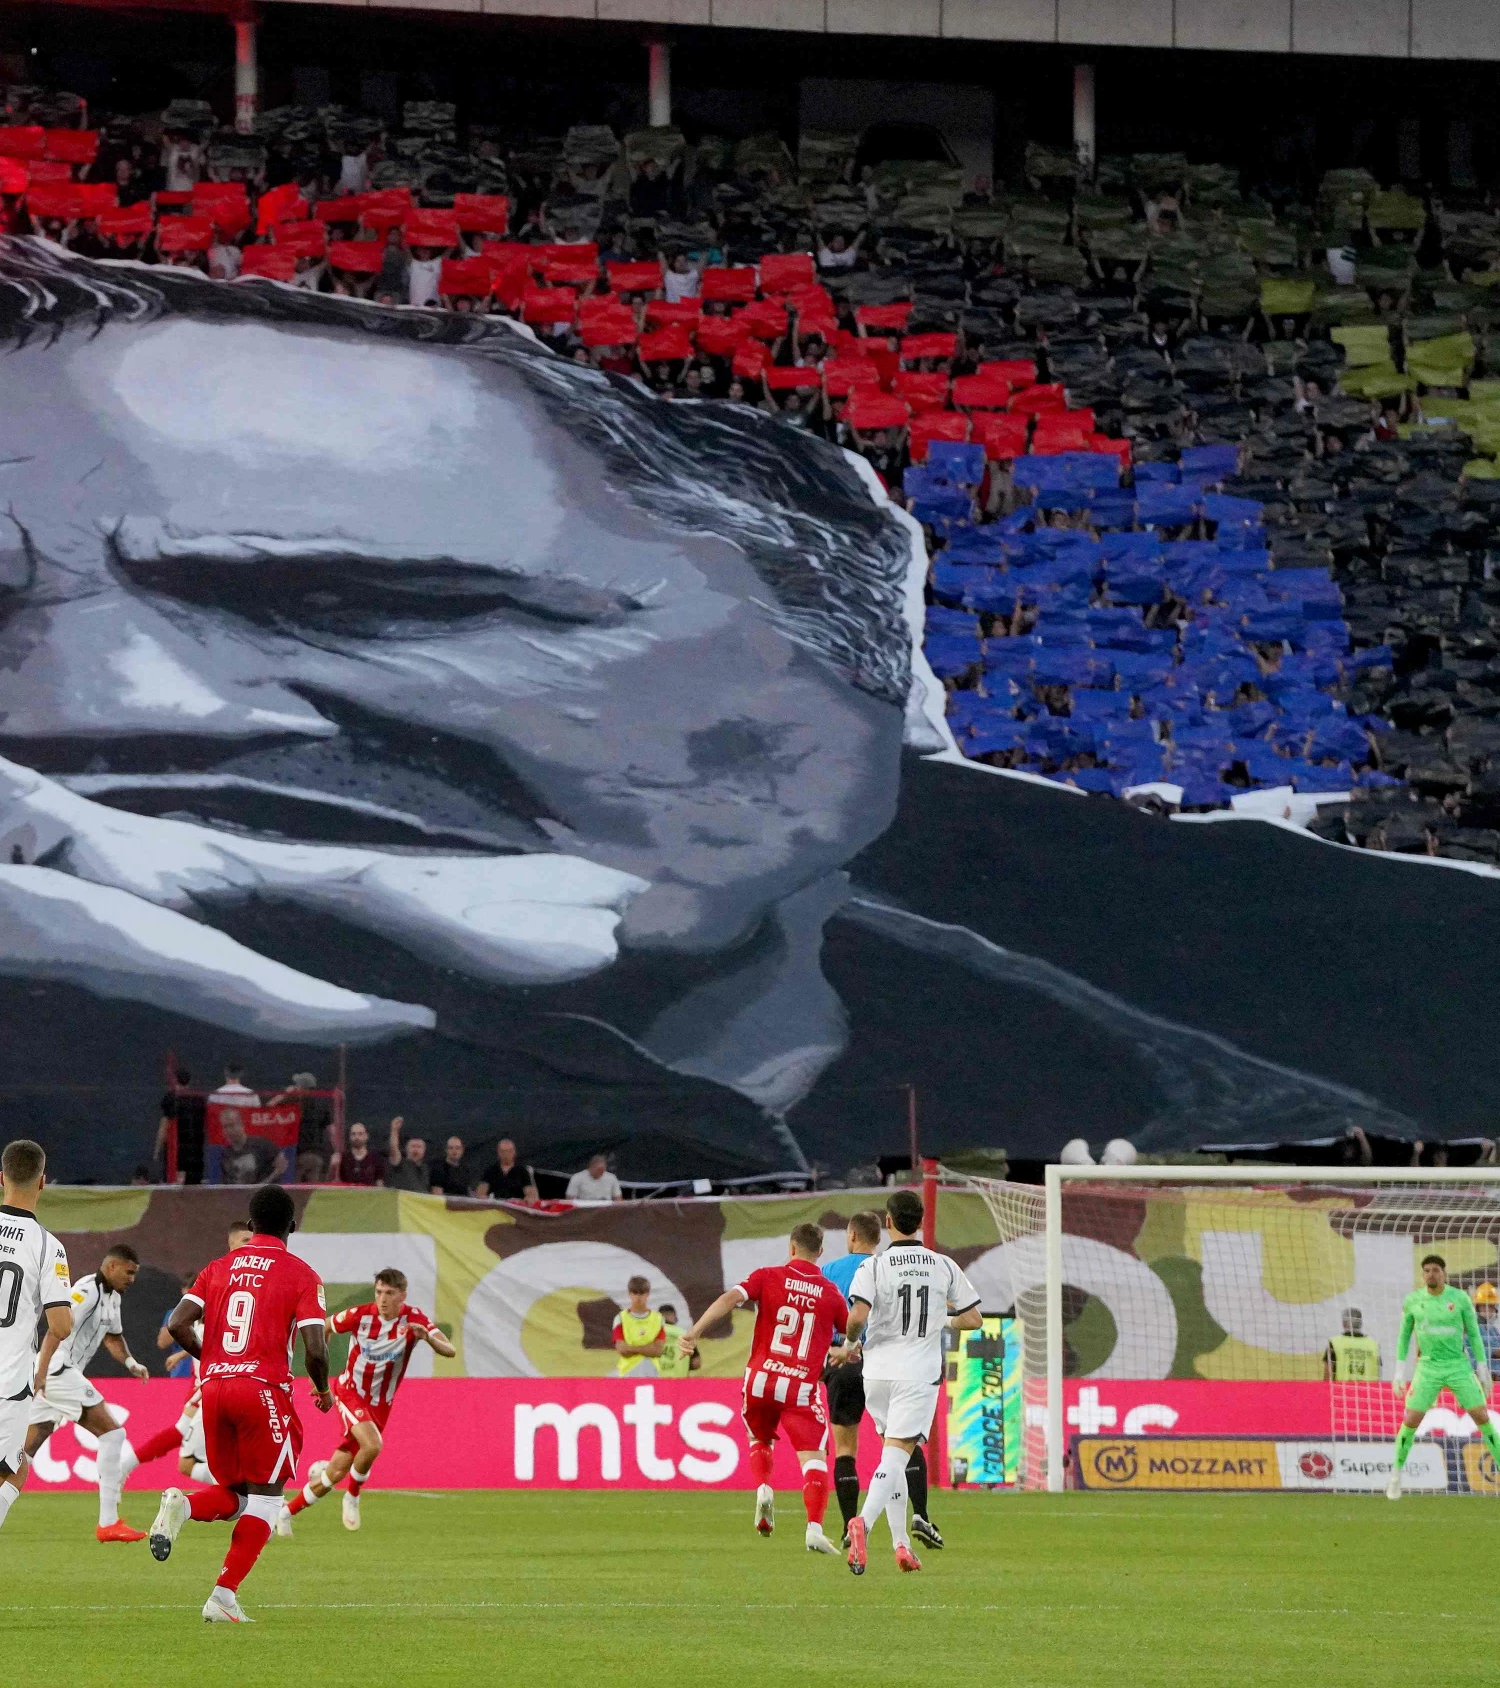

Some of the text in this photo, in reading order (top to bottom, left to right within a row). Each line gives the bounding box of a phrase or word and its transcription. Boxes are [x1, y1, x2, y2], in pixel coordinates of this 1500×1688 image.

[230, 1255, 276, 1272] ДИЈЕНГ
[889, 1254, 936, 1267] ВУКОТИЋ
[229, 1273, 264, 1288] МТС
[787, 1292, 817, 1310] МТС
[897, 1283, 929, 1338] 11
[221, 1290, 256, 1357] 9
[770, 1305, 816, 1361] 21
[514, 1384, 740, 1483] mts
[981, 1405, 1004, 1477] FORCE
[1148, 1457, 1269, 1477] MOZZART
[1340, 1458, 1431, 1477] Superiga
